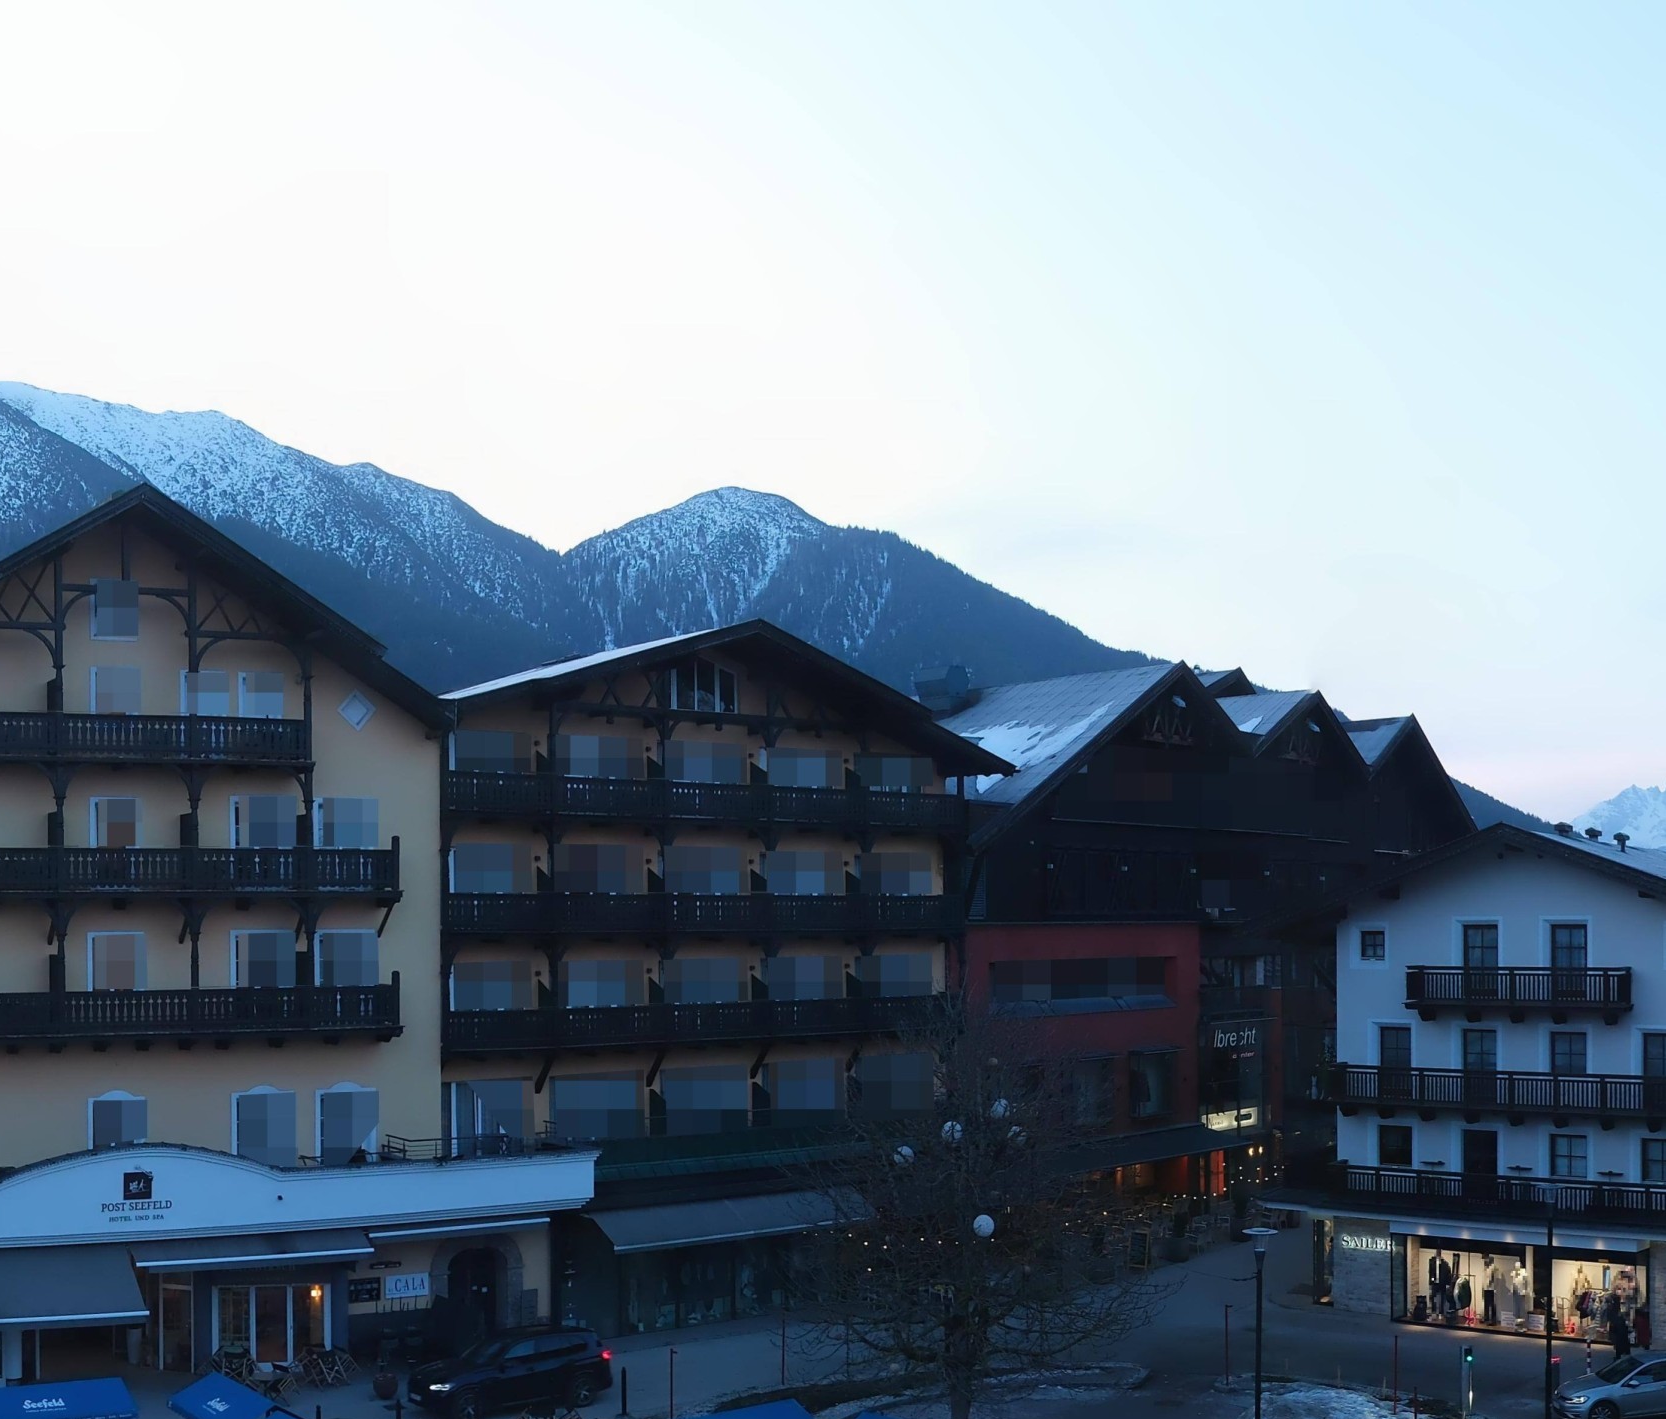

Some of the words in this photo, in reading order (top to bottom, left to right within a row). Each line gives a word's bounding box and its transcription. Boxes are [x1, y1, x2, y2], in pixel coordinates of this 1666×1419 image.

[1233, 1051, 1255, 1059] cnter
[101, 1202, 126, 1213] POST
[130, 1200, 172, 1212] SEEFELD
[1342, 1234, 1395, 1252] SAILER
[394, 1277, 425, 1292] CALA
[23, 1397, 66, 1409] Seefeld
